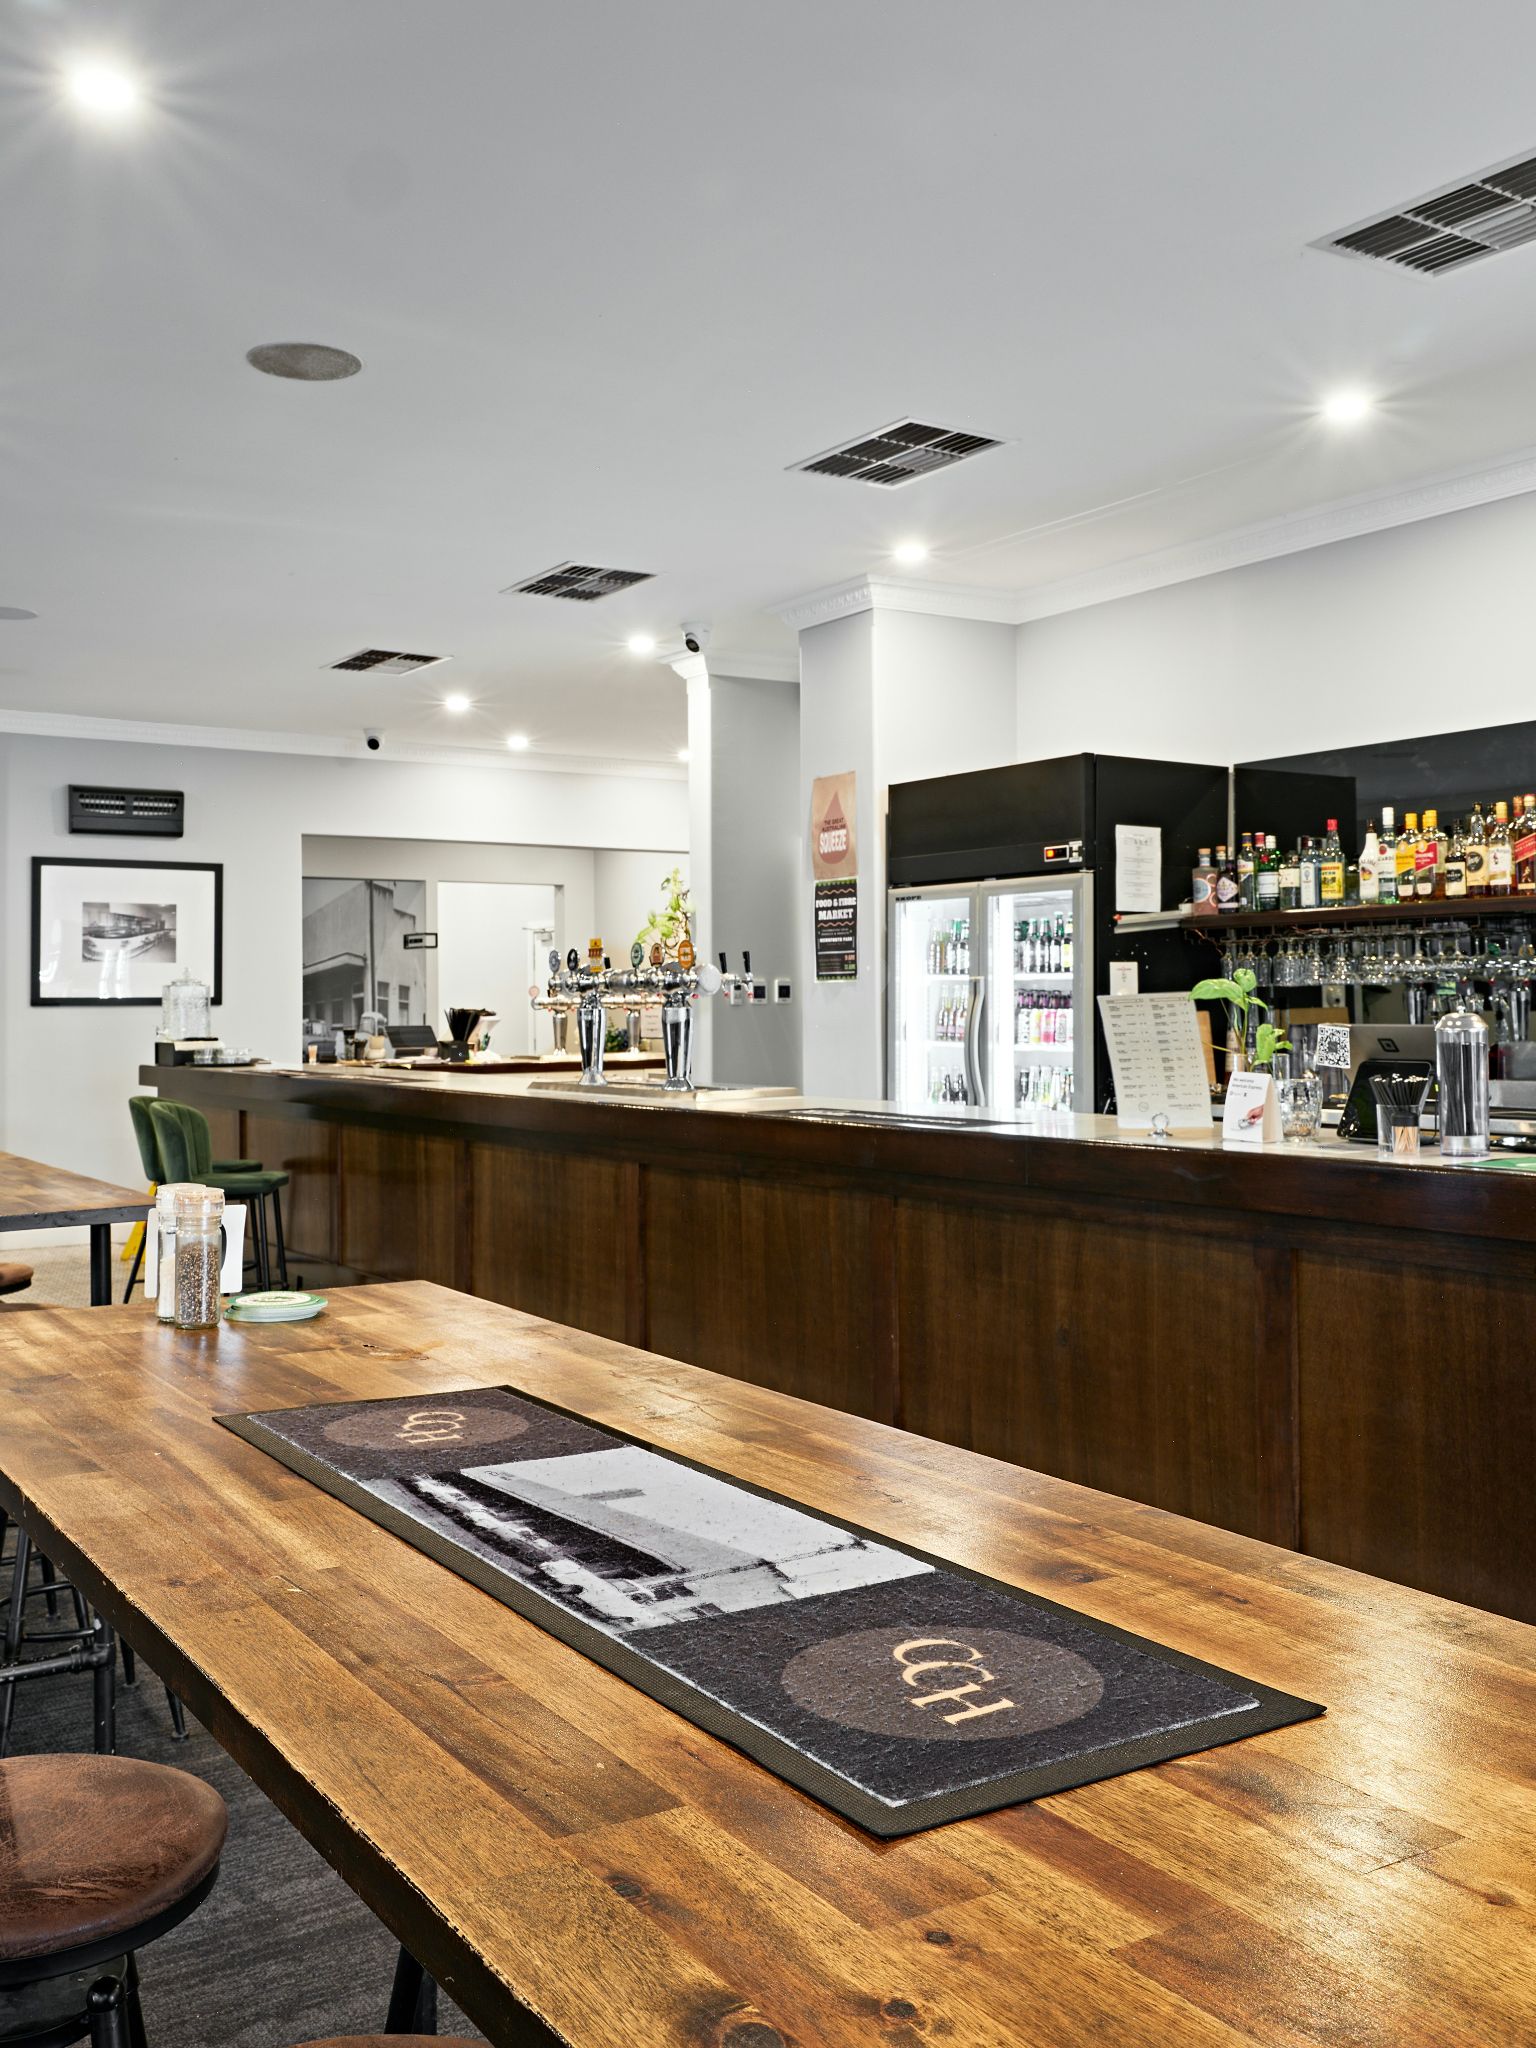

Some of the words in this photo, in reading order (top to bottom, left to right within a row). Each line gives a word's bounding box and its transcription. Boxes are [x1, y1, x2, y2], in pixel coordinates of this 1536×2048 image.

[819, 829, 847, 854] SQUEEZE
[816, 899, 832, 908] FOOD
[818, 909, 853, 920] MARKET
